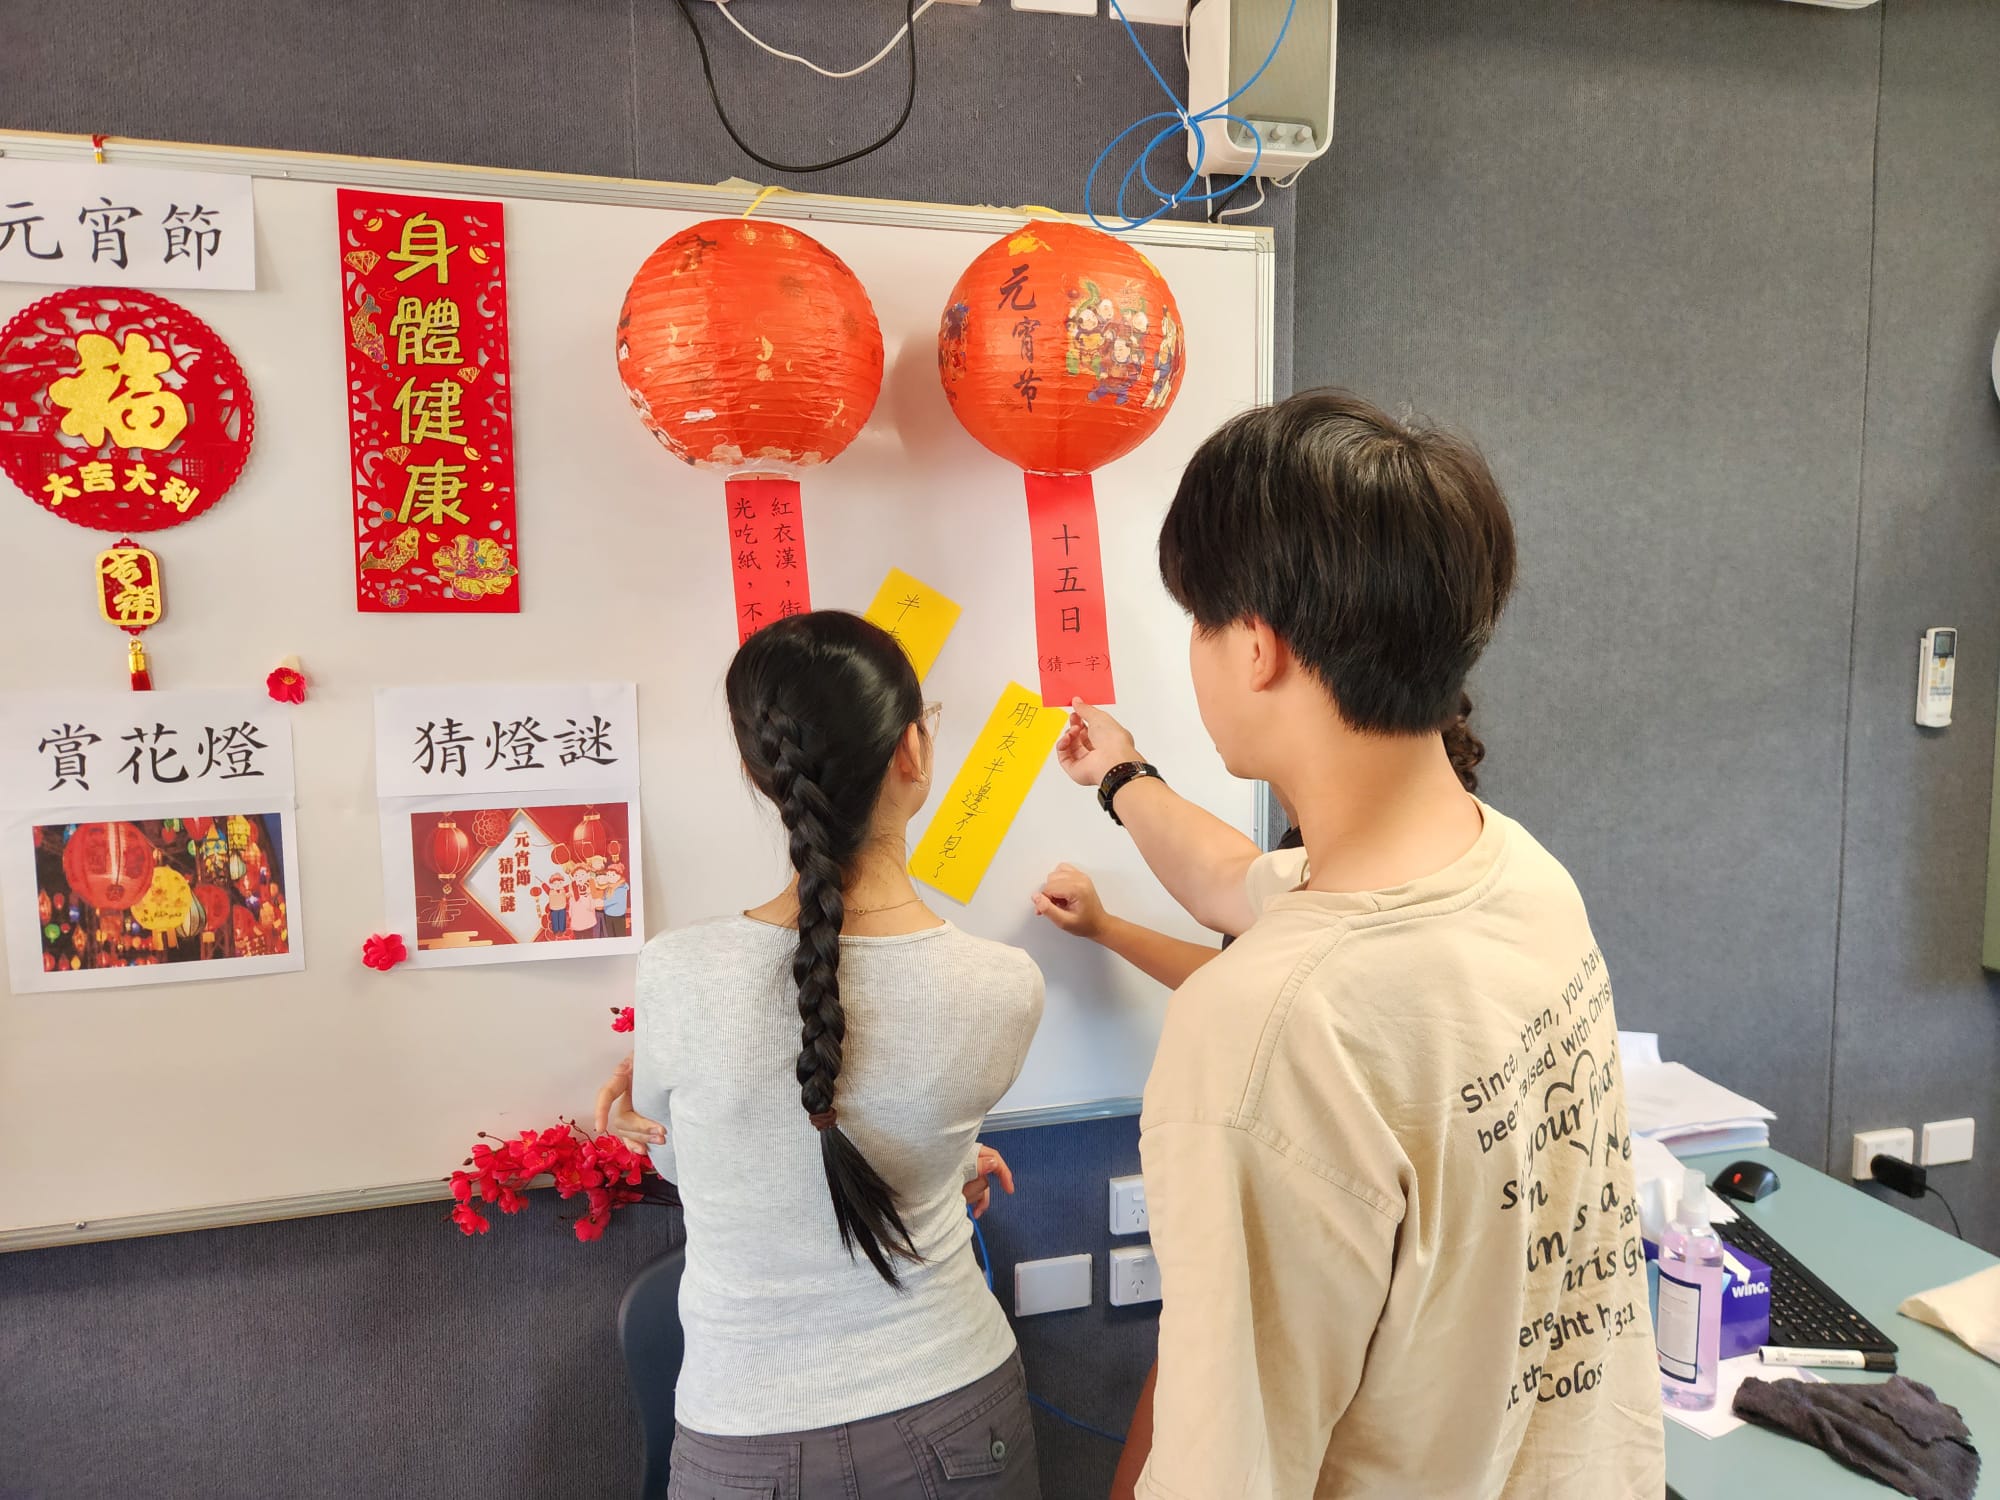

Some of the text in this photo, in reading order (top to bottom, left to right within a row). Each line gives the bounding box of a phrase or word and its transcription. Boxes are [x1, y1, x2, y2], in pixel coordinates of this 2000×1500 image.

[0, 196, 222, 271] 元宵節
[387, 212, 471, 525] 身體健康
[997, 263, 1042, 413] 元宵节
[48, 332, 188, 449] 福
[42, 463, 200, 513] 大吉大利
[101, 553, 156, 621] 吉祥
[1051, 523, 1087, 634] 十五日
[37, 721, 270, 791] 賞花燈
[412, 715, 621, 777] 猜燈謎
[514, 831, 531, 887] 元宵節
[1461, 1053, 1519, 1114] Since,
[1520, 1008, 1560, 1053] then,
[1561, 973, 1584, 1015] you
[1561, 1016, 1591, 1057] with
[1588, 976, 1613, 1024] Chris
[1731, 1281, 1769, 1299] winc.
